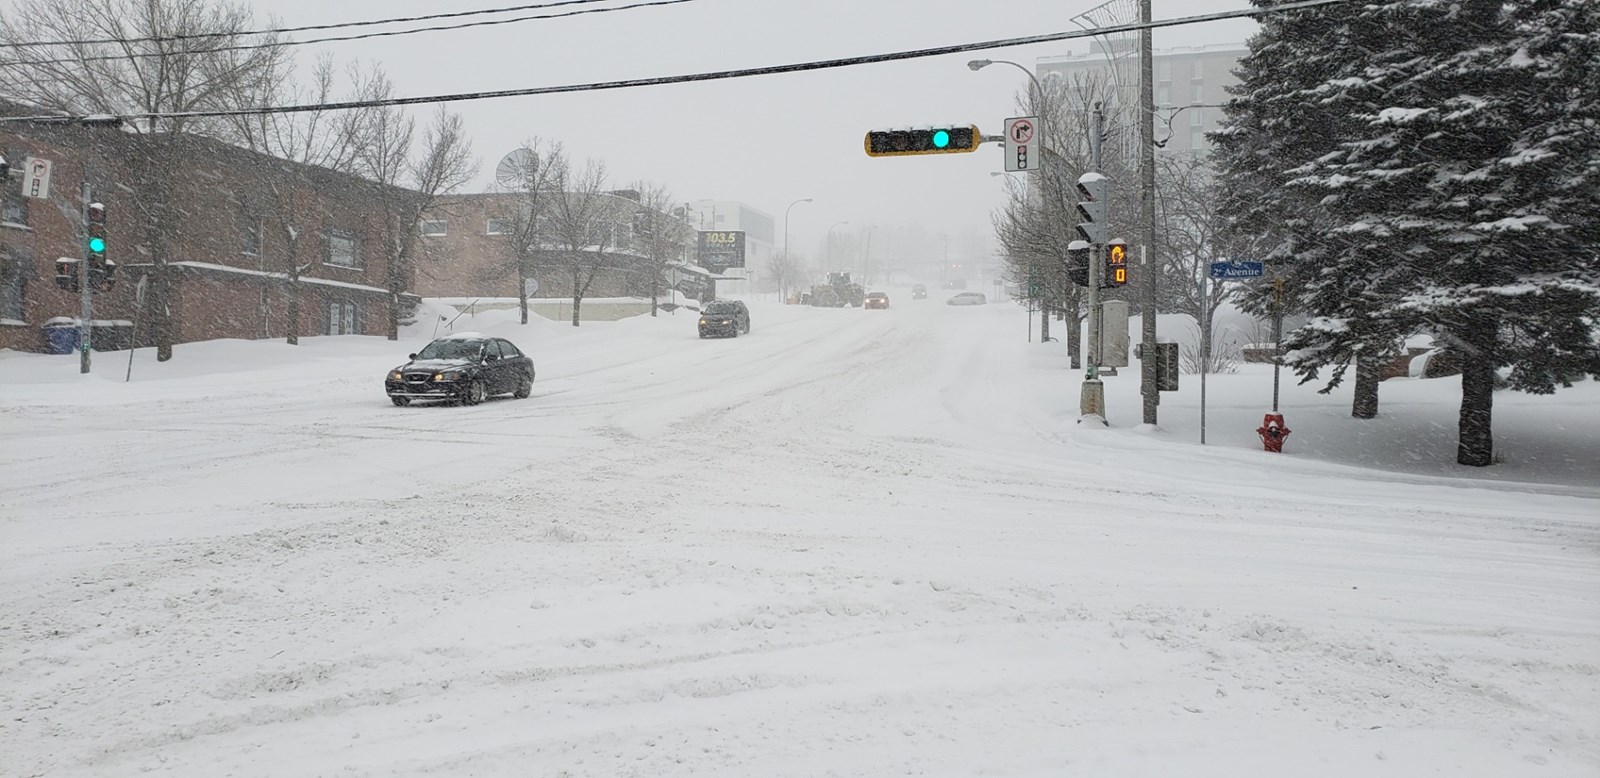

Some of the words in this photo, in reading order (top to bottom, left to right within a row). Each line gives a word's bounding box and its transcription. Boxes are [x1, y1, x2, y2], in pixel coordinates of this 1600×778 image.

[705, 232, 736, 243] 103.5
[1116, 269, 1125, 282] 0
[1224, 268, 1260, 276] Avenue
